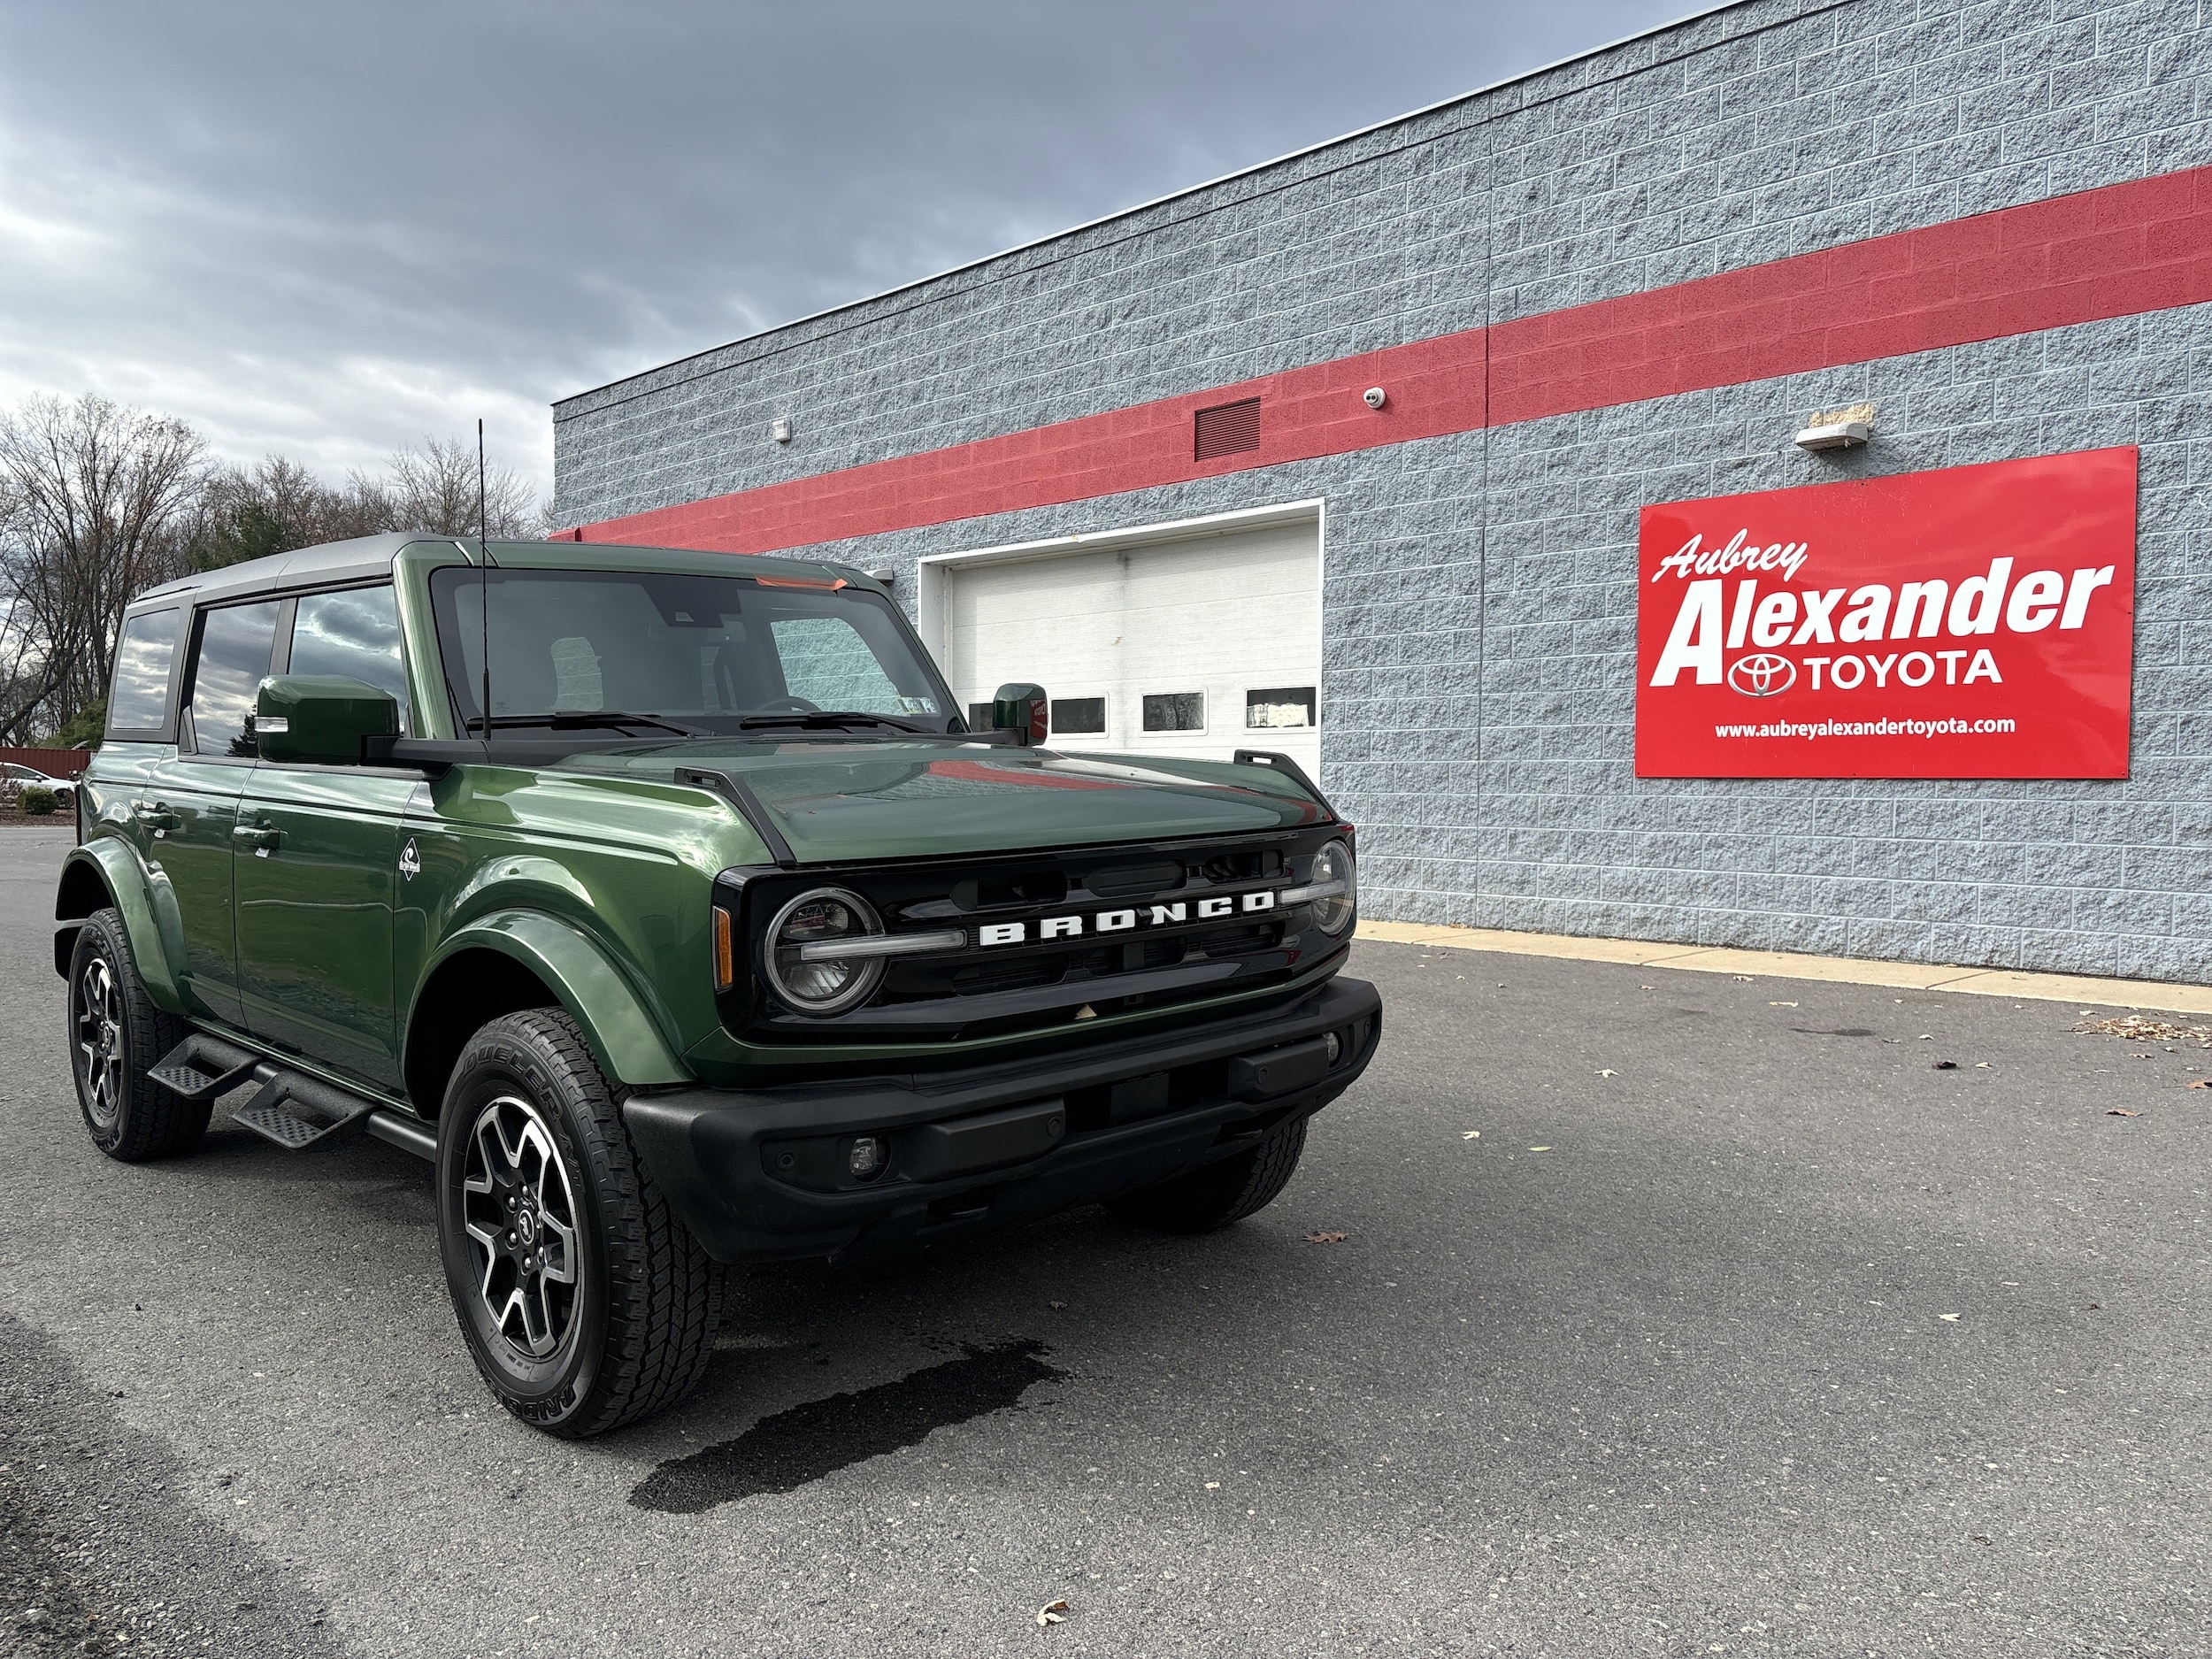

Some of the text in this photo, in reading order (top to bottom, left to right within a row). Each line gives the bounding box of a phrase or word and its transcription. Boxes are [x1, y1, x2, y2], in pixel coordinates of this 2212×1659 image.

[1651, 527, 1809, 583] Aubrey
[1649, 557, 2116, 687] Alexander
[1802, 649, 2003, 690] TOYOTA
[1715, 717, 2016, 741] www.aubreyalexandertoyota.com
[979, 891, 1275, 947] BRONCO
